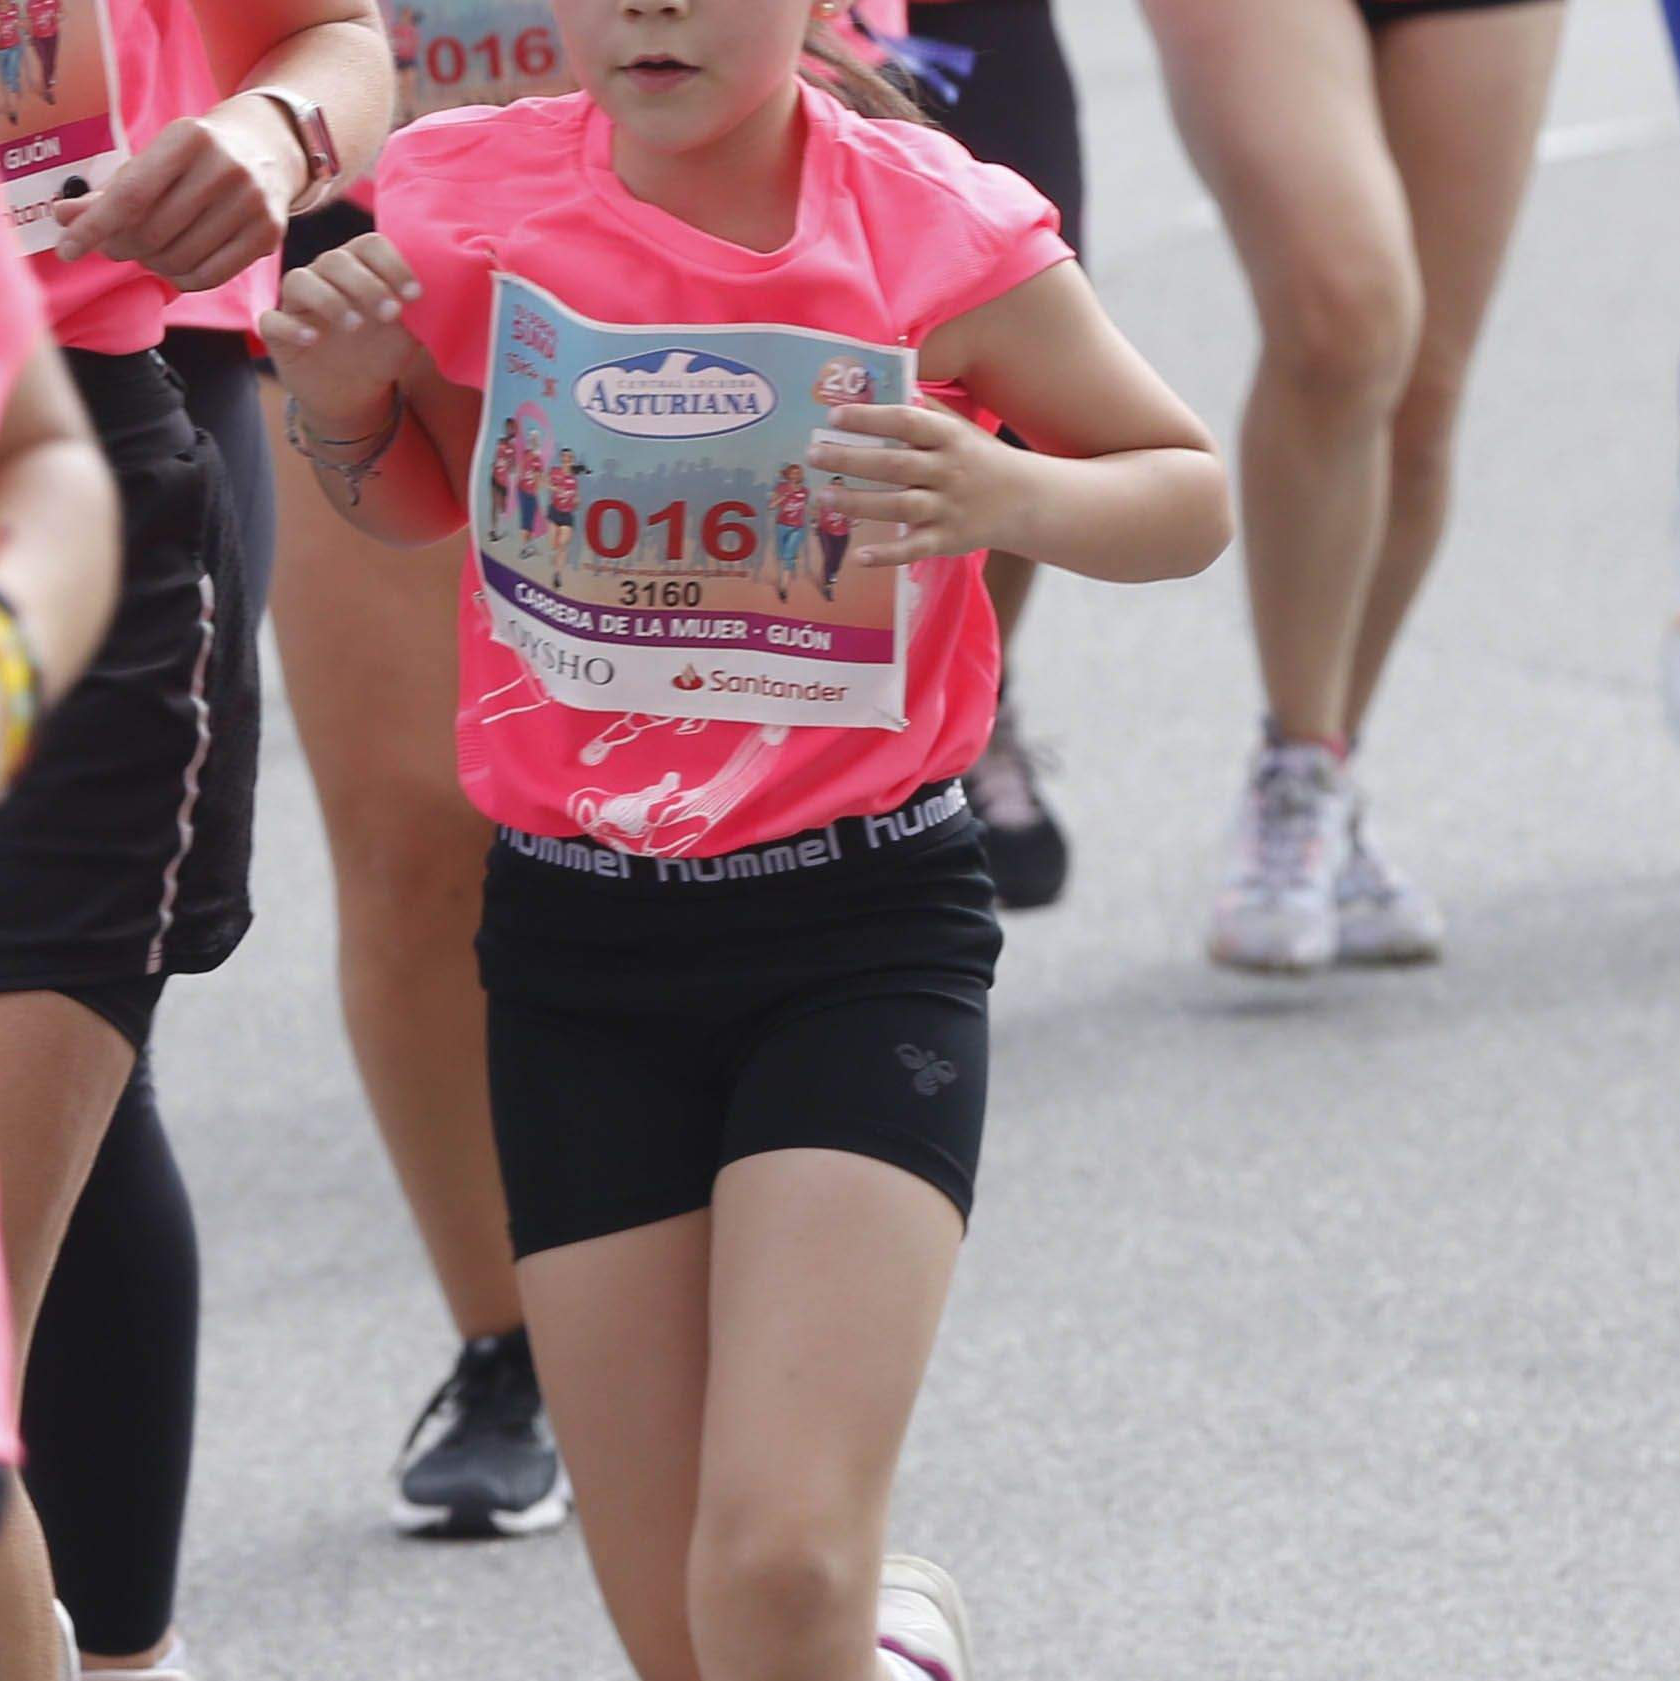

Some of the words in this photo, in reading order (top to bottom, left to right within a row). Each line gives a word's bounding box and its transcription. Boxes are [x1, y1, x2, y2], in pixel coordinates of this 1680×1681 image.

[426, 28, 556, 84] 016
[583, 380, 761, 415] ASTURIANA
[583, 498, 758, 562] 016
[514, 582, 594, 633] CARRERA
[599, 614, 630, 636] DE
[635, 617, 666, 638] LA
[670, 618, 748, 640] MUJER
[620, 580, 702, 608] 3160
[709, 669, 851, 703] Santander
[654, 824, 842, 882] hummel
